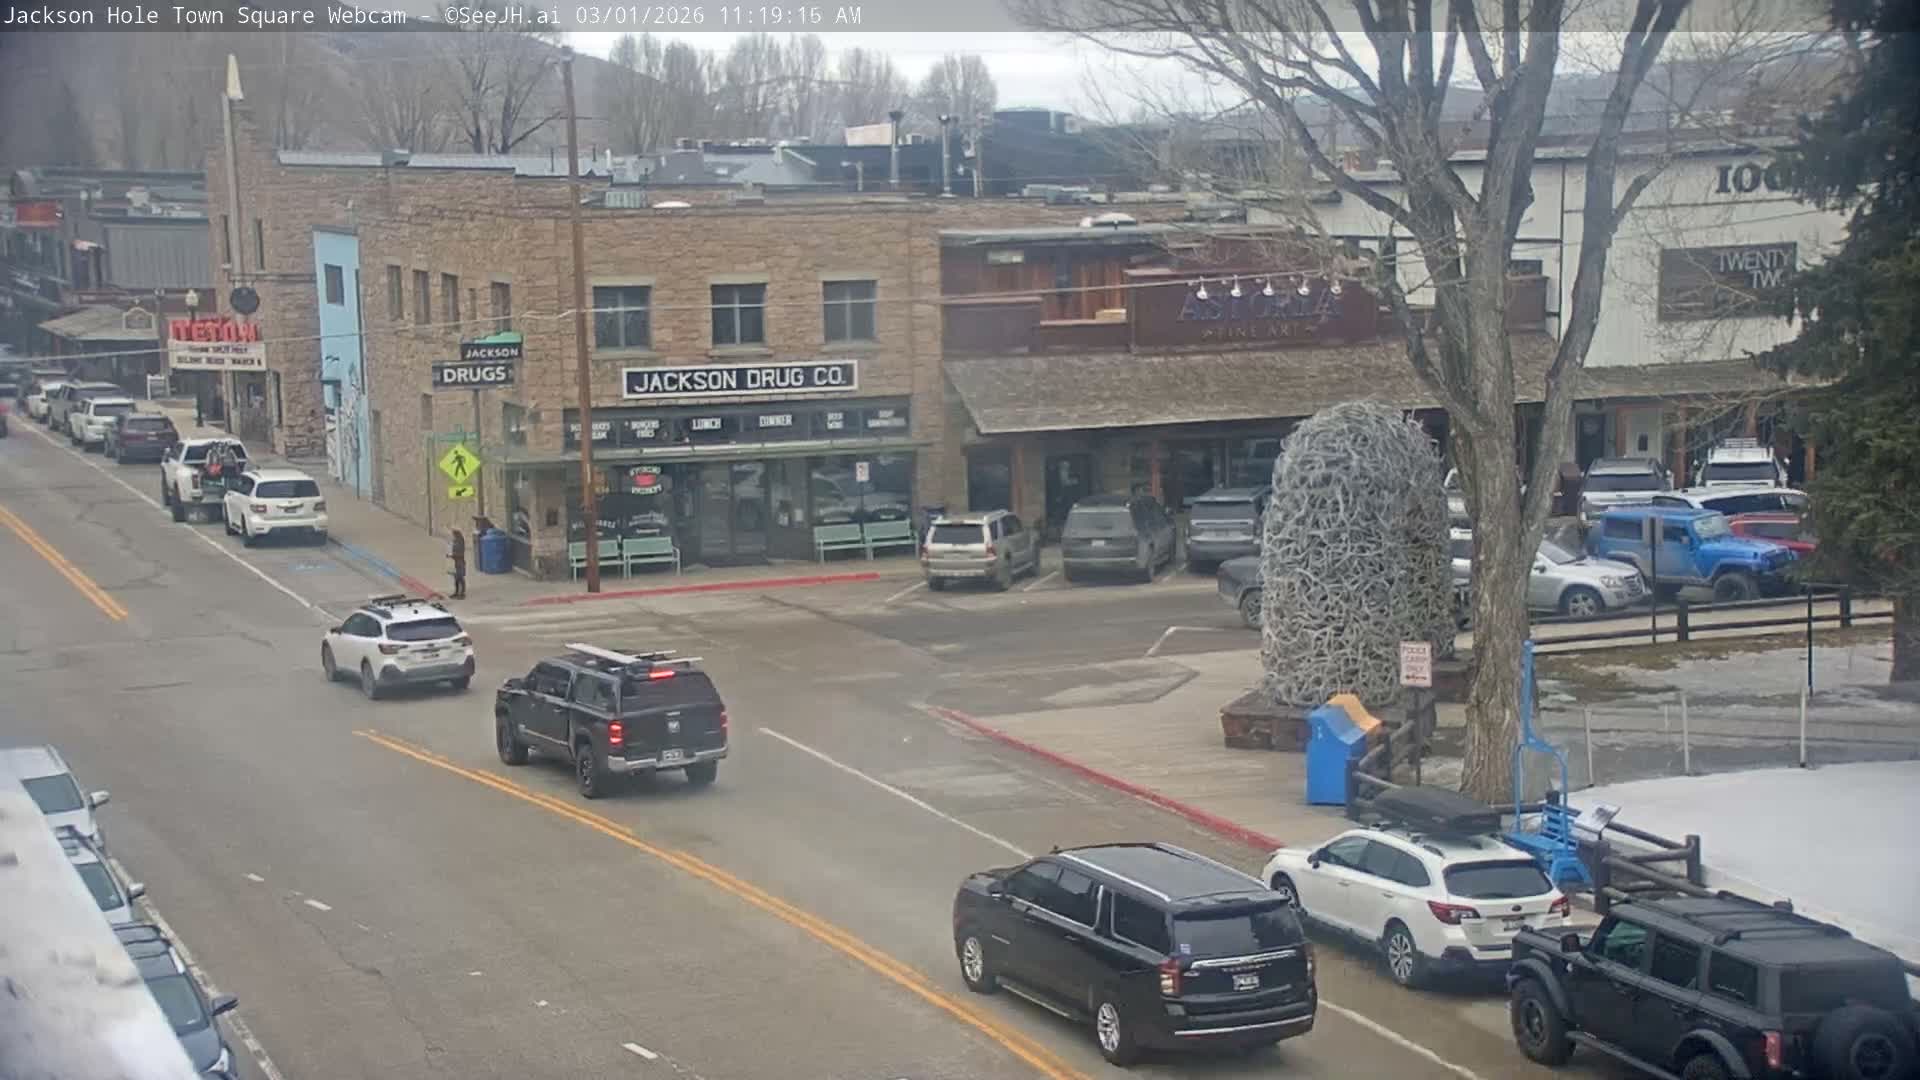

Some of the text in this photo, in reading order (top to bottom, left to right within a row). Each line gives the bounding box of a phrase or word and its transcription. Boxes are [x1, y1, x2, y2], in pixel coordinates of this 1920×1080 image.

[1718, 250, 1789, 273] TWENTY
[1267, 324, 1299, 337] ART
[466, 347, 518, 358] JACKSON
[443, 366, 506, 383] DRUGS
[634, 366, 847, 392] JACKSON DRUG CO.
[692, 418, 721, 430] LUNCH
[759, 414, 793, 427] DINNER
